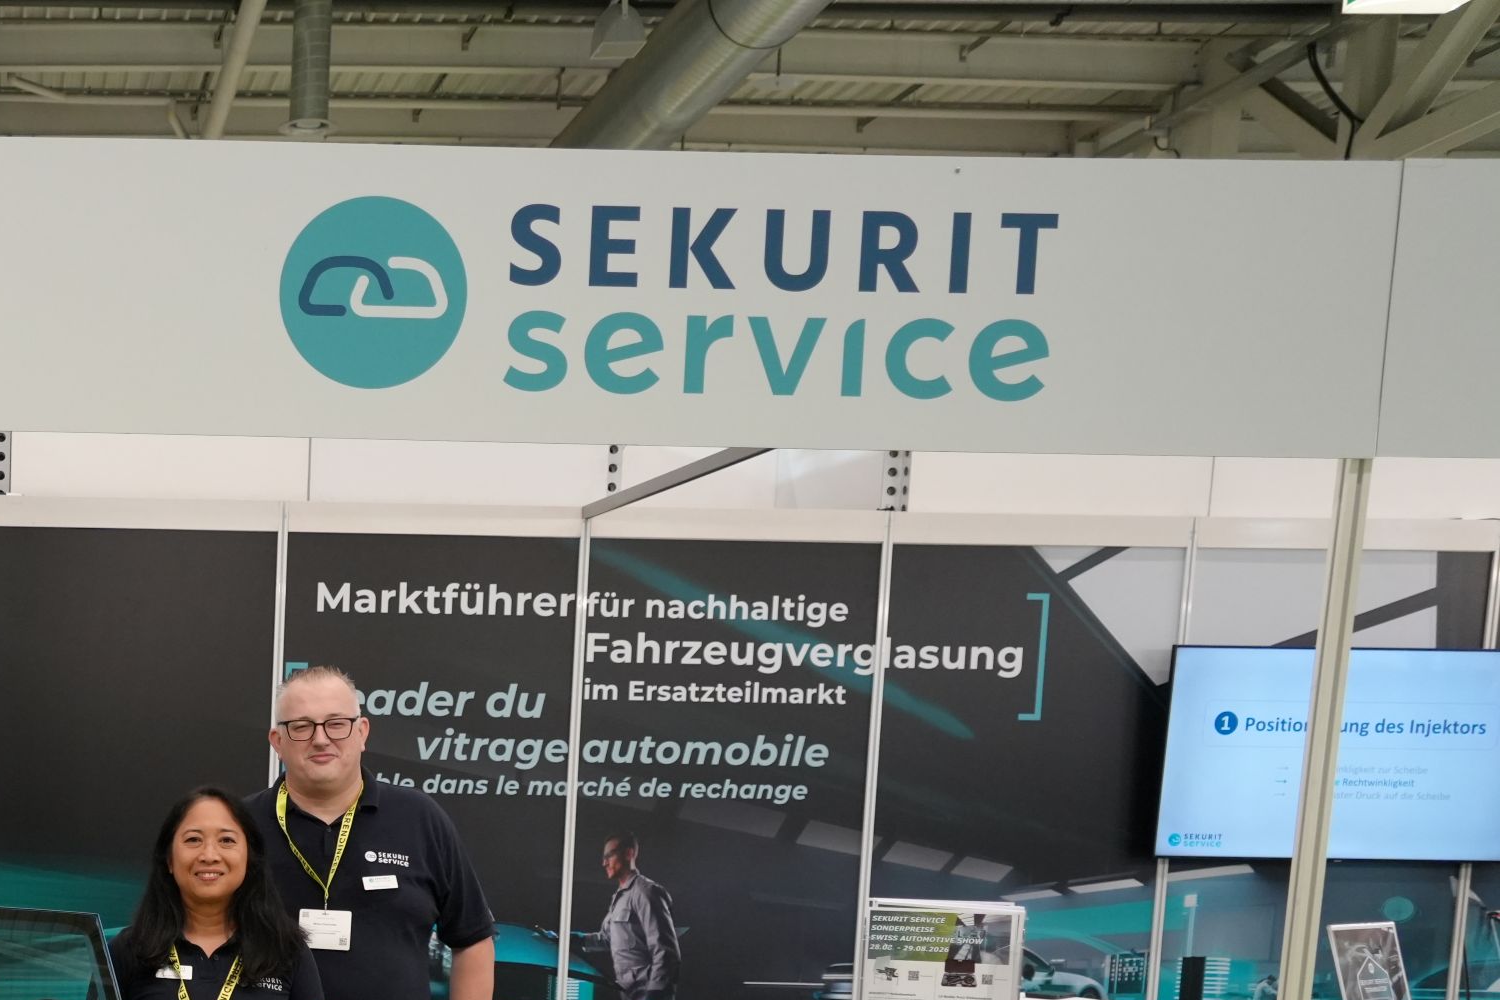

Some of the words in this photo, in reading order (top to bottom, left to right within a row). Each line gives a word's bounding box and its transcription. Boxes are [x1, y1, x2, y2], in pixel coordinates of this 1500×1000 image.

[509, 203, 1060, 295] SEKURIT
[503, 309, 1050, 402] service
[315, 581, 576, 618] Marktführer
[586, 591, 635, 619] für
[645, 594, 849, 628] nachhaltige
[585, 632, 1025, 679] Fahrzeugverglasung
[485, 682, 546, 719] du
[583, 678, 619, 702] im
[628, 680, 847, 706] Ersatzteilmarkt
[1374, 718, 1404, 735] des
[1409, 718, 1487, 738] Injektors
[417, 728, 570, 770] vitrage
[581, 734, 830, 769] automobile
[422, 773, 488, 795] dans
[495, 775, 518, 796] le
[639, 777, 672, 798] de
[679, 779, 809, 805] rechange
[1342, 777, 1415, 789] Rechtwinkligkeit
[377, 851, 410, 862] SEKURIT
[377, 857, 410, 868] service
[870, 924, 936, 933] SONDERPREISE
[871, 915, 909, 923] SEKURIT
[910, 916, 947, 924] SERVICE
[870, 934, 898, 942] SWISS
[900, 935, 956, 944] AUTOMOTIVE
[956, 938, 984, 946] SHOW
